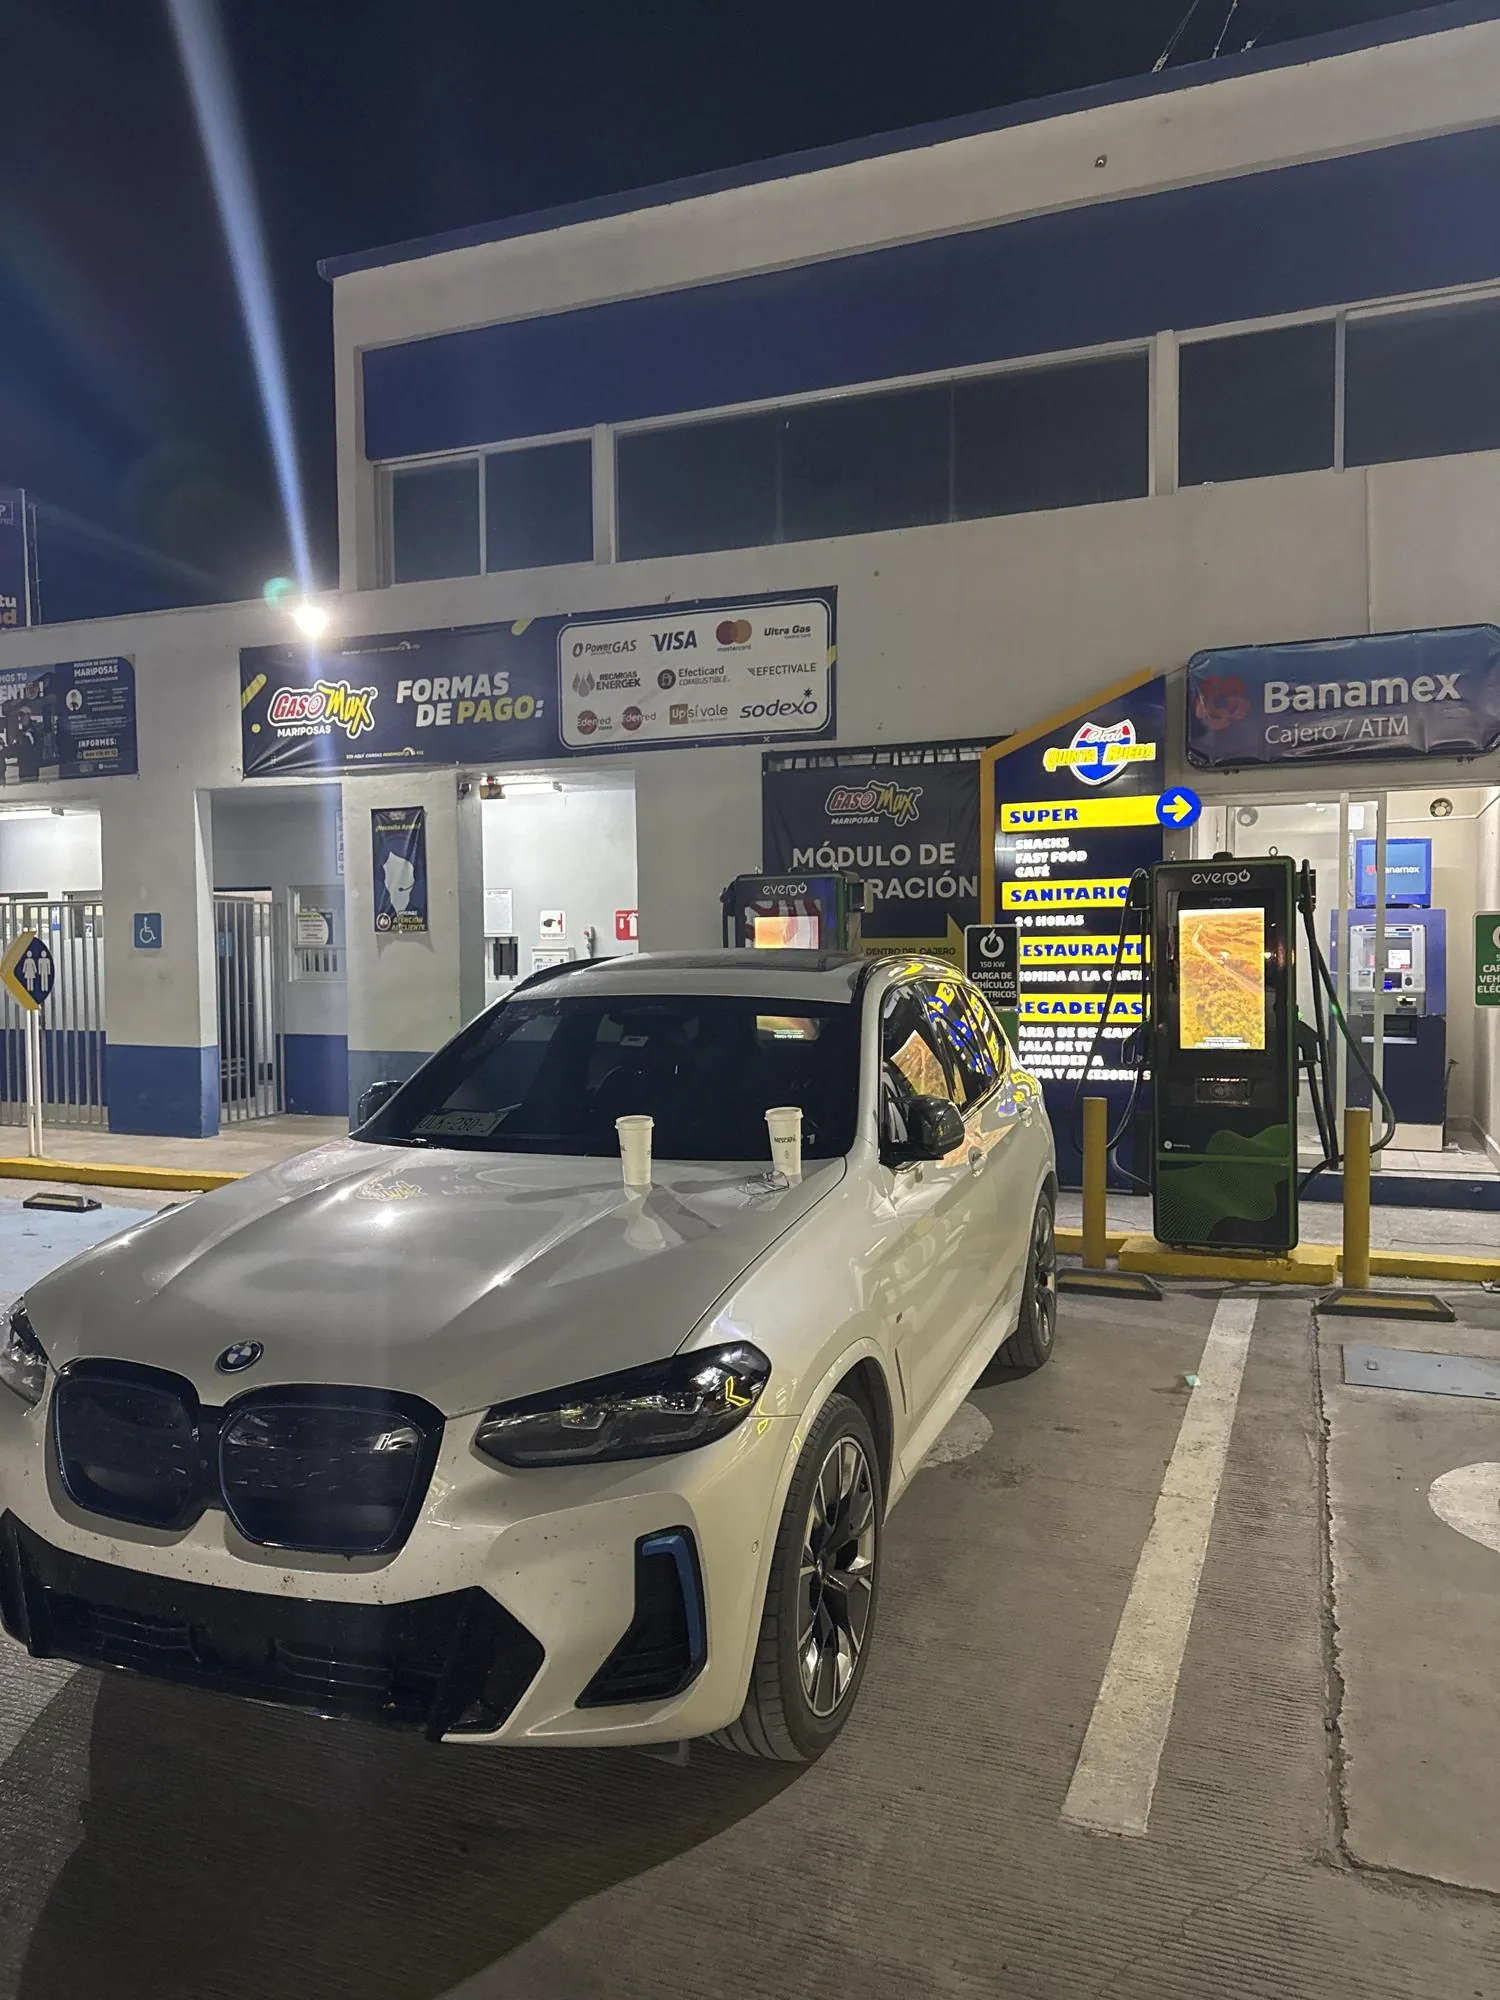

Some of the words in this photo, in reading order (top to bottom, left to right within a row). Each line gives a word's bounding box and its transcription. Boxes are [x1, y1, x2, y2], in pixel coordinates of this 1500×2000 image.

[651, 630, 698, 652] VISA
[792, 624, 811, 634] Gas
[16, 672, 27, 682] TU
[74, 664, 118, 678] MARIPOSAS
[678, 665, 724, 677] Efecticard
[756, 663, 817, 677] EFECTIVALE
[396, 671, 510, 704] FORMAS
[596, 677, 641, 691] ENERGEX
[1263, 673, 1462, 714] Banamex
[415, 703, 452, 728] DE
[457, 695, 544, 725] PAGO:
[672, 708, 686, 720] Up
[740, 697, 818, 719] sodexo
[277, 725, 332, 738] MARIPOSAS
[1264, 724, 1337, 747] Cajero
[1357, 715, 1410, 738] ATM
[1046, 748, 1097, 771] QUINTA
[831, 816, 880, 825] MARIPOSAS
[1009, 808, 1078, 824] SUPER
[1015, 837, 1070, 851] SNACKS
[792, 840, 911, 869] MÓDULO
[919, 842, 956, 866] DE
[1015, 852, 1049, 865] FAST
[1050, 850, 1088, 863] FOOD
[1015, 864, 1050, 878] CAFÉ
[1385, 865, 1420, 874] anamex
[1191, 868, 1251, 886] evergo
[762, 882, 808, 897] evergo
[868, 871, 978, 900] RACIÓN
[1010, 886, 1129, 903] SANITARIO
[1014, 915, 1034, 928] 24
[1035, 914, 1085, 927] HORAS
[901, 947, 919, 956] DEL
[920, 946, 956, 956] CAJERO
[971, 971, 1000, 980] CARGA
[1000, 971, 1012, 980] DE
[1081, 970, 1100, 982] LA
[976, 980, 1015, 989] EHÍCULOS
[1057, 1026, 1076, 1039] DE
[1054, 1041, 1074, 1052] DE
[1054, 1068, 1065, 1080] Y
